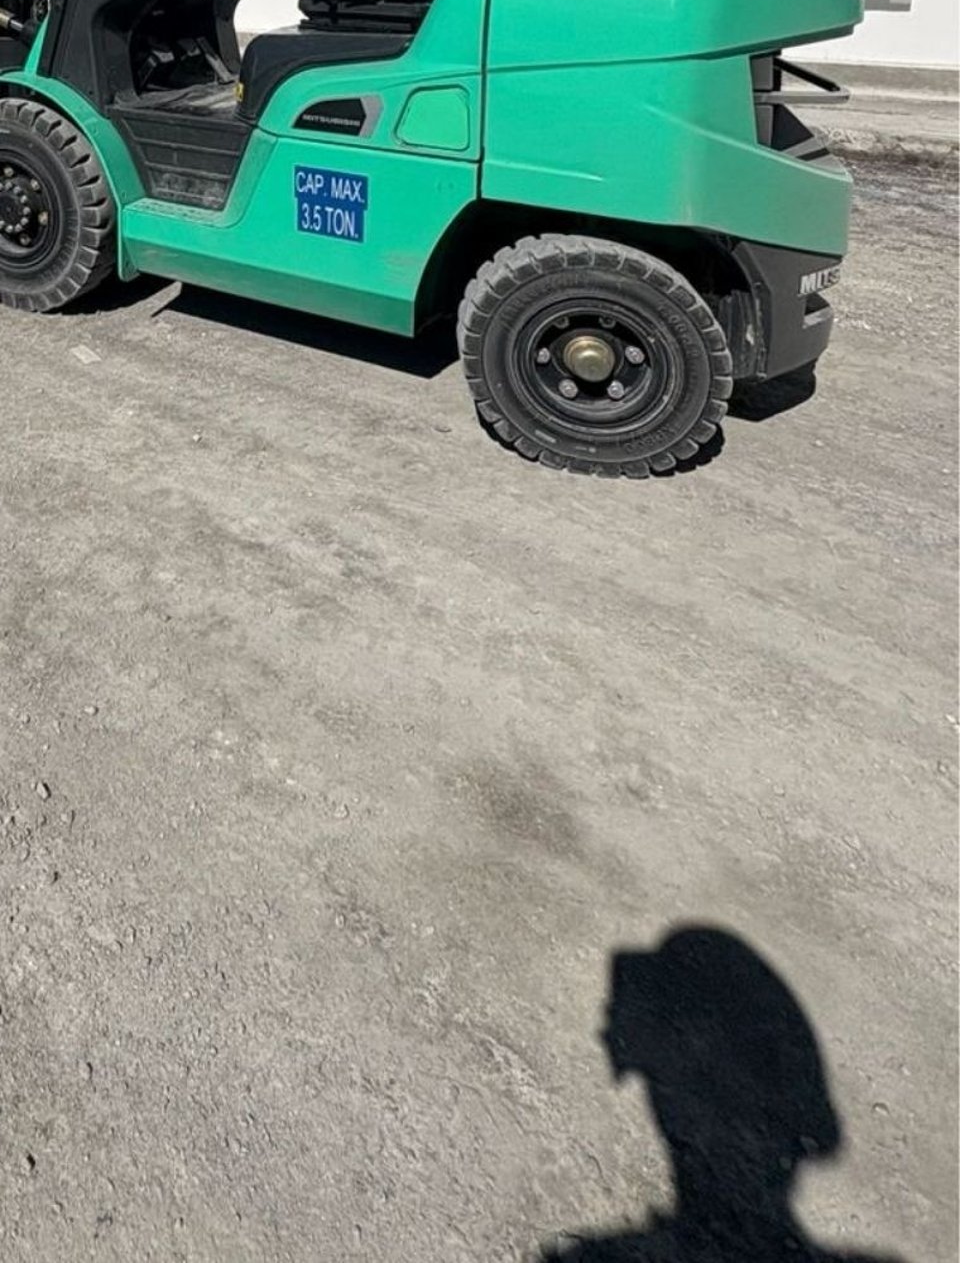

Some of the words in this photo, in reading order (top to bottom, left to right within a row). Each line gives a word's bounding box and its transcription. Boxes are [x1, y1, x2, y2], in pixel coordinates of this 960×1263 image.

[296, 171, 328, 197] CAP.
[301, 203, 322, 231] 3.5
[324, 206, 359, 238] TON.
